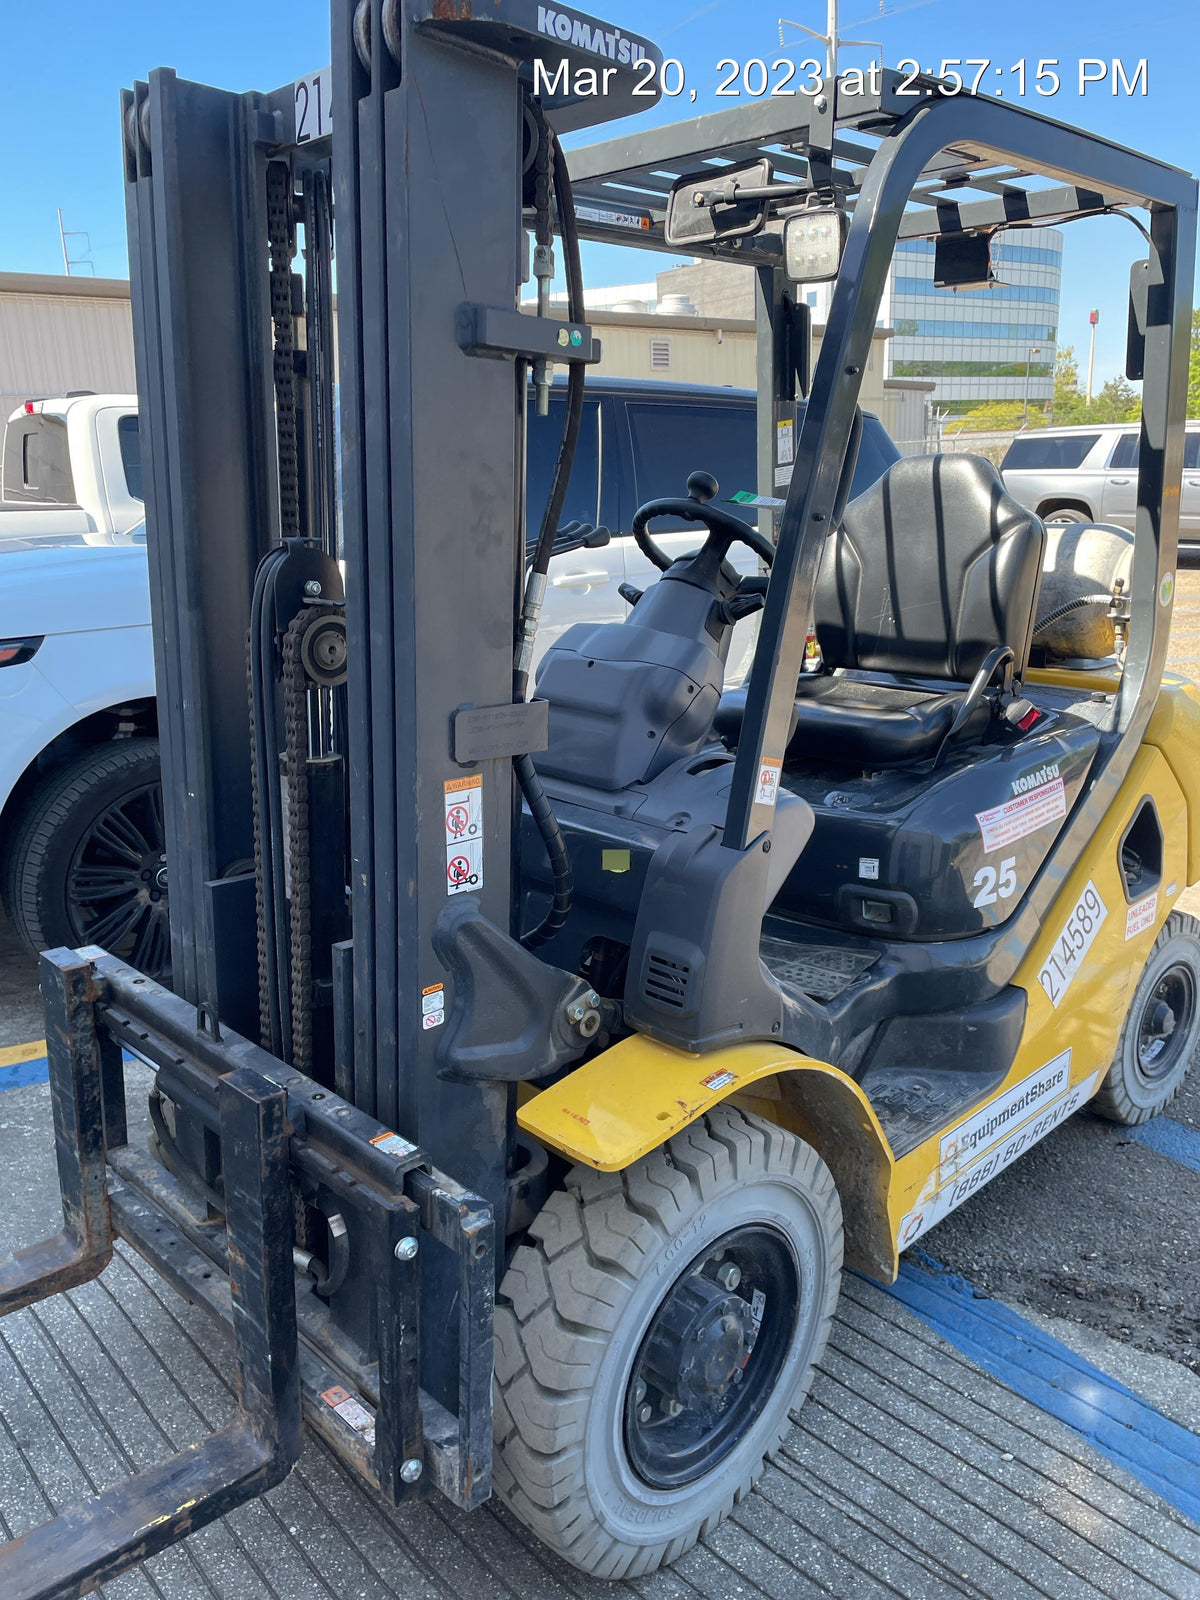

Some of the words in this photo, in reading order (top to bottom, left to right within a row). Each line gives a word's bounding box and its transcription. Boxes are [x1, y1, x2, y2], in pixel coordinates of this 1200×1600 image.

[537, 5, 645, 70] KOMATSU
[296, 76, 332, 143] 21
[452, 777, 481, 789] WARNING
[1011, 764, 1060, 796] KOMATSU
[973, 855, 1017, 909] 25
[1128, 897, 1156, 921] UNLEADED
[1040, 887, 1102, 1001] 214589
[1127, 921, 1140, 936] FUEL
[1140, 912, 1154, 927] ONLY
[960, 1069, 1064, 1150] EquipmentShare
[948, 1153, 1000, 1208] (888)
[1003, 1092, 1079, 1163] 80-RENTS
